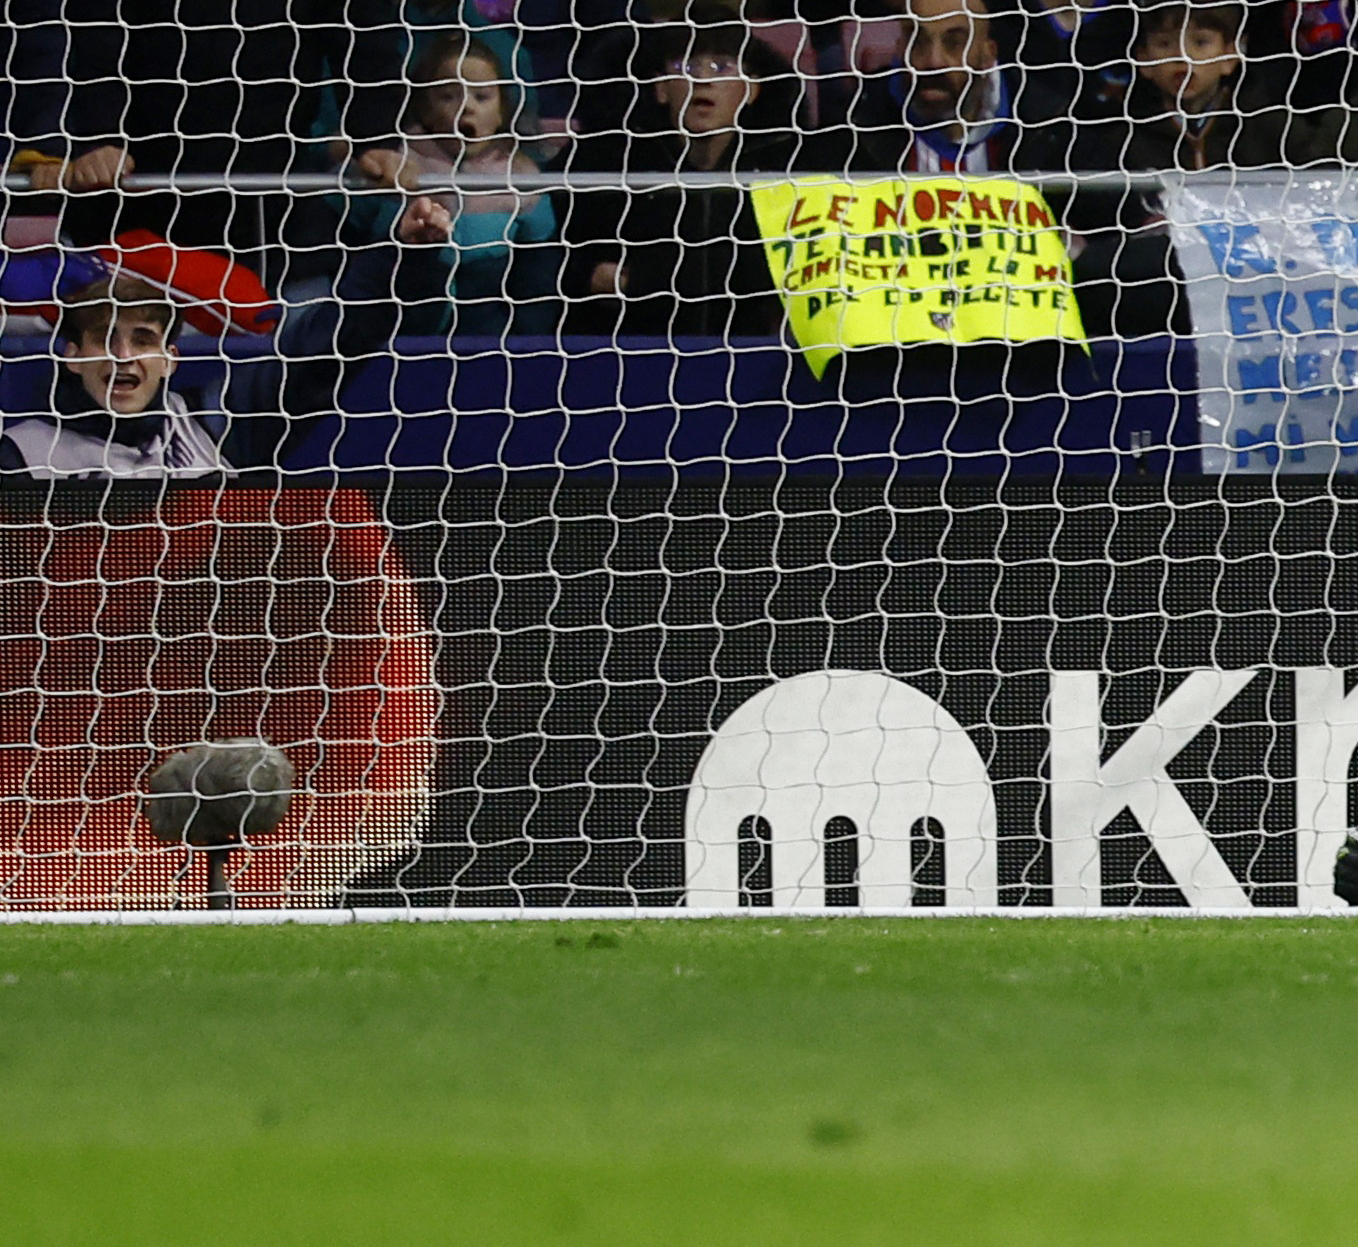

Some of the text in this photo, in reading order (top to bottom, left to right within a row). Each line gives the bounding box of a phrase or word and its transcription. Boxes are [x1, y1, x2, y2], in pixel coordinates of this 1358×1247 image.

[786, 188, 1051, 232] LE NORMAN
[808, 285, 861, 319] DEL
